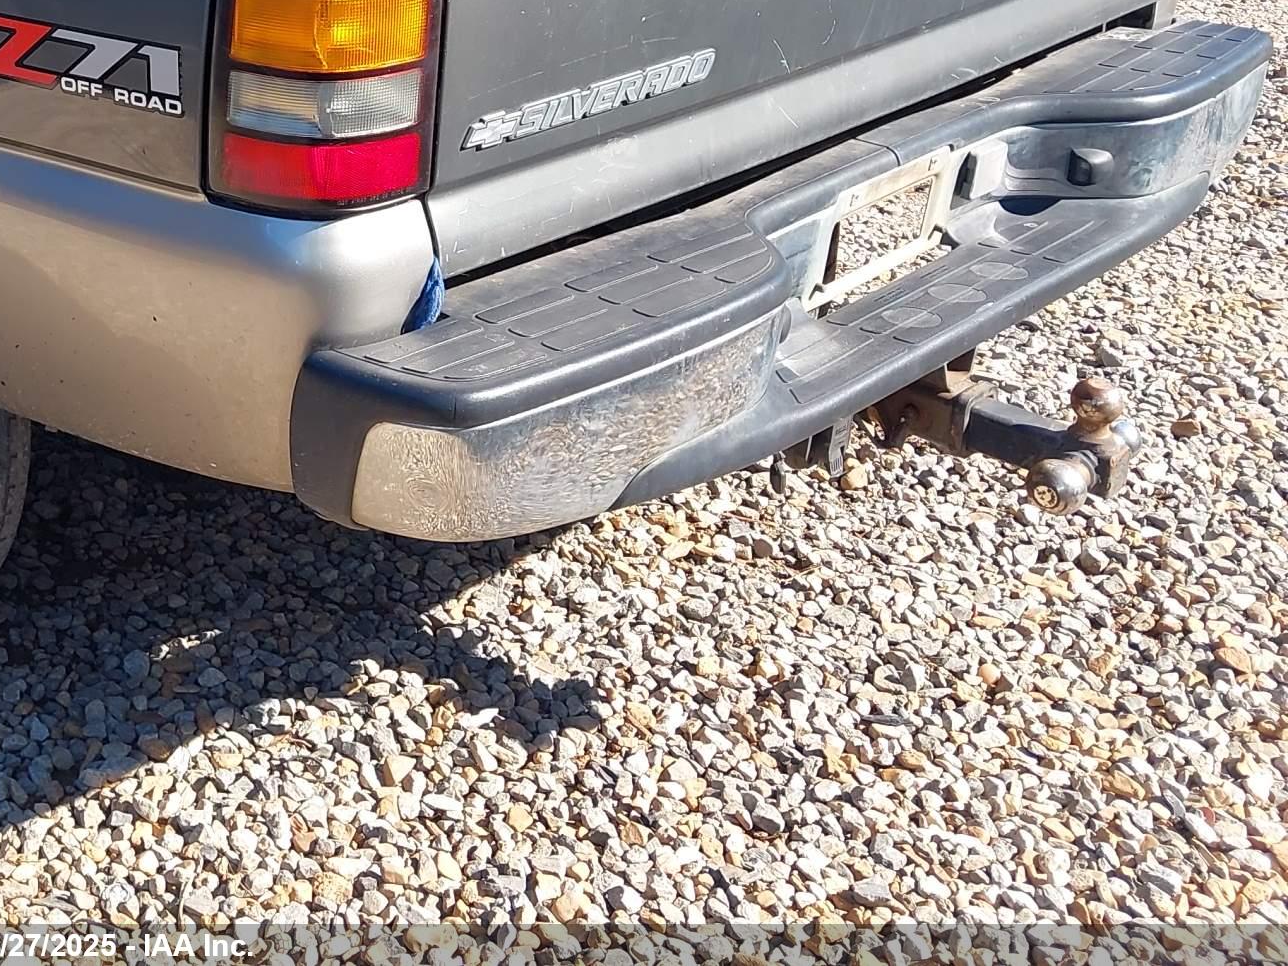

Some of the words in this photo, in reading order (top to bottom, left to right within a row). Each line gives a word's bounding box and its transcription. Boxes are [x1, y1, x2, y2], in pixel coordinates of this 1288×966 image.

[61, 77, 103, 97] OFF
[114, 88, 183, 115] ROAD
[514, 48, 716, 139] SILVERADO
